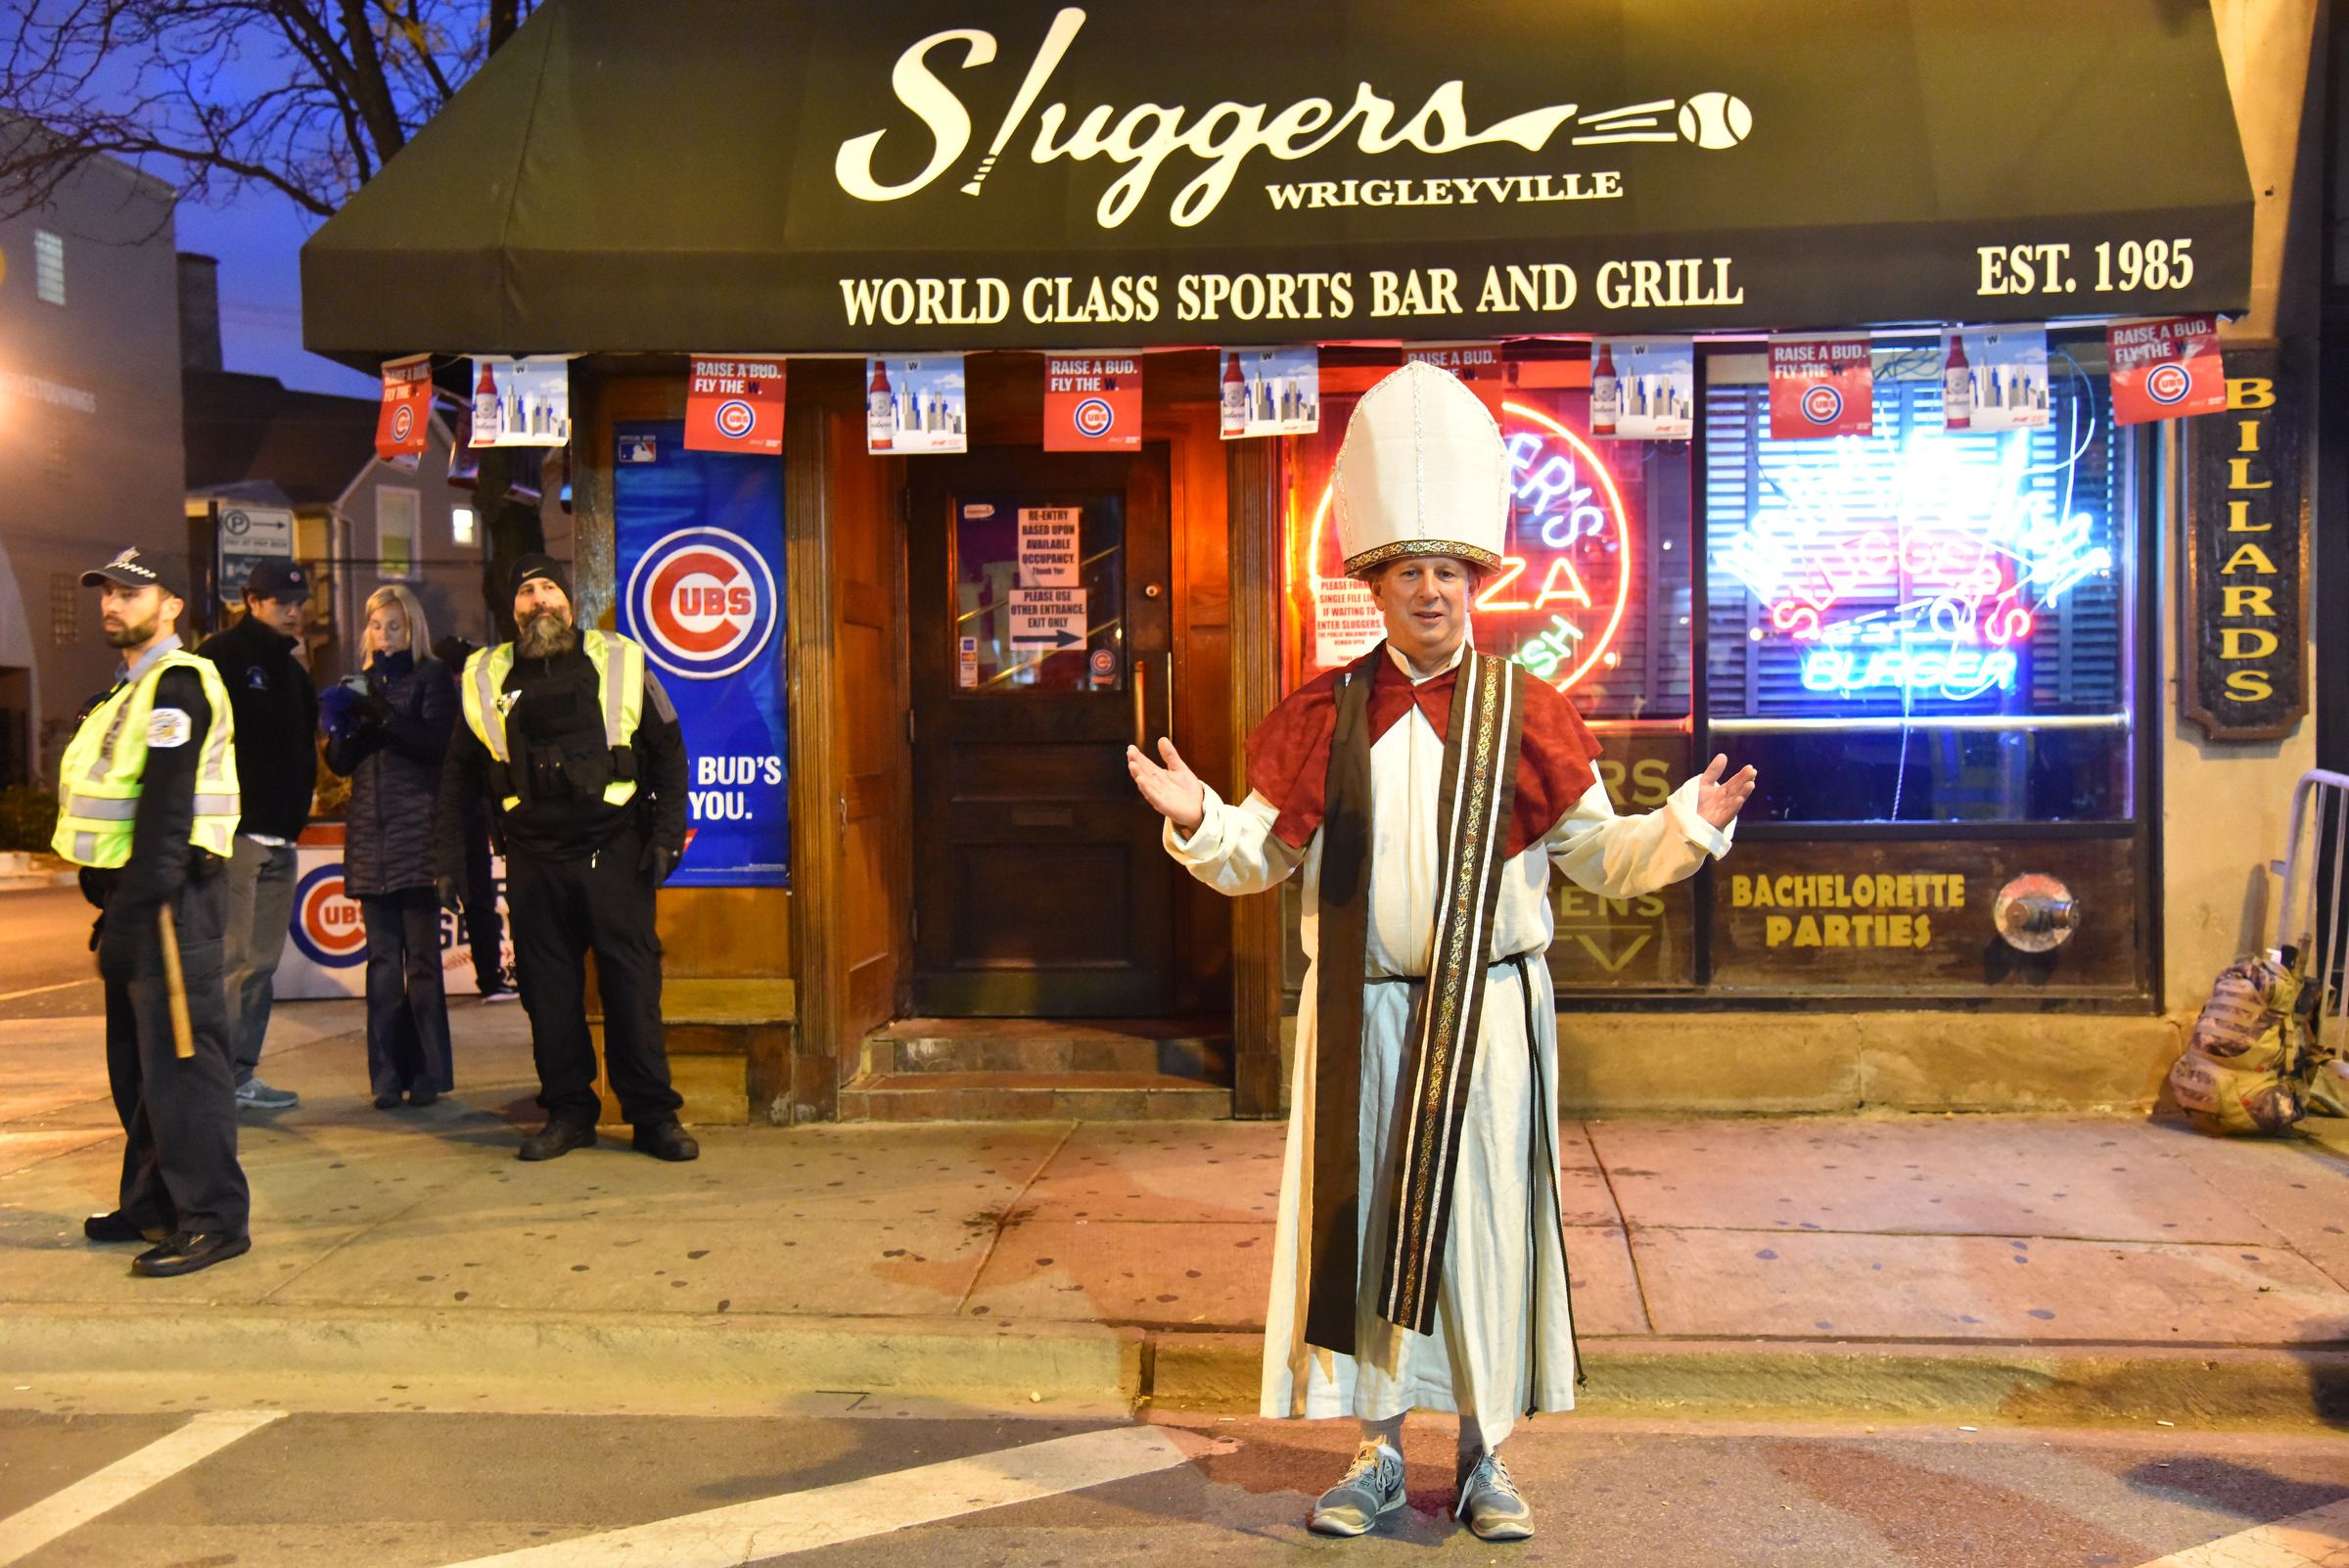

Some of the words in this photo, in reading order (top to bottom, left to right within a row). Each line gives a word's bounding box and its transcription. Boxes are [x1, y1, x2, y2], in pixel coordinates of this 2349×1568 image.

[835, 7, 1578, 229] Sluggers
[1265, 170, 1624, 210] WRIGLEYVILLE
[1976, 244, 2077, 296] EST.
[2095, 238, 2194, 292] 1985
[839, 277, 1010, 326] WORLD
[1022, 275, 1160, 324] CLASS
[1177, 273, 1355, 321] SPORTS
[1369, 268, 1463, 317] BAR
[1476, 263, 1578, 313] AND
[1595, 257, 1744, 309] GRILL
[1987, 335, 1998, 345] W
[2114, 326, 2156, 346] RAISE
[2160, 324, 2170, 339] A
[2173, 319, 2212, 338] BUD.
[1450, 351, 1460, 365] A
[1463, 350, 1497, 365] BUD.
[1635, 346, 1645, 355] W
[1774, 346, 1816, 361] RAISE
[1819, 346, 1828, 360] A
[1831, 344, 1866, 360] BUD.
[696, 362, 735, 377] RAISE
[737, 363, 747, 378] A
[749, 363, 782, 379] BUD.
[908, 361, 918, 371] W
[1050, 360, 1090, 375] RAISE
[1092, 360, 1103, 374] A
[1105, 359, 1137, 374] BUD.
[1774, 363, 1798, 380] FLY
[1800, 362, 1828, 379] THE
[695, 379, 716, 392] FLY
[719, 379, 745, 393] THE
[1050, 378, 1073, 392] FLY
[1075, 377, 1101, 392] THE
[1029, 510, 1069, 521] RE-ENTRY
[1022, 525, 1050, 535] BASED
[1052, 525, 1075, 534] UPON
[1027, 539, 1071, 549] AVAILABLE
[2219, 378, 2279, 703] BILLARDS
[1321, 580, 1347, 590] PLEASE
[651, 552, 752, 653] CUBS
[1024, 591, 1053, 602] PLEASE
[1055, 591, 1072, 601] USE
[1319, 594, 1345, 604] SINGLE
[1347, 594, 1361, 603] FILE
[1011, 605, 1037, 616] OTHER
[1323, 608, 1329, 617] IF
[1331, 607, 1364, 617] WAITING
[1366, 607, 1376, 616] TO
[1028, 618, 1045, 628] EXIT
[1048, 617, 1069, 627] ONLY
[1317, 621, 1340, 630] ENTER
[1803, 651, 2019, 692] BURGER
[698, 756, 782, 785] BUD'S
[687, 791, 753, 820] YOU.
[1731, 873, 1965, 909] BACHELORETTE
[305, 880, 366, 950] CUB
[1766, 913, 1931, 948] PARTIES
